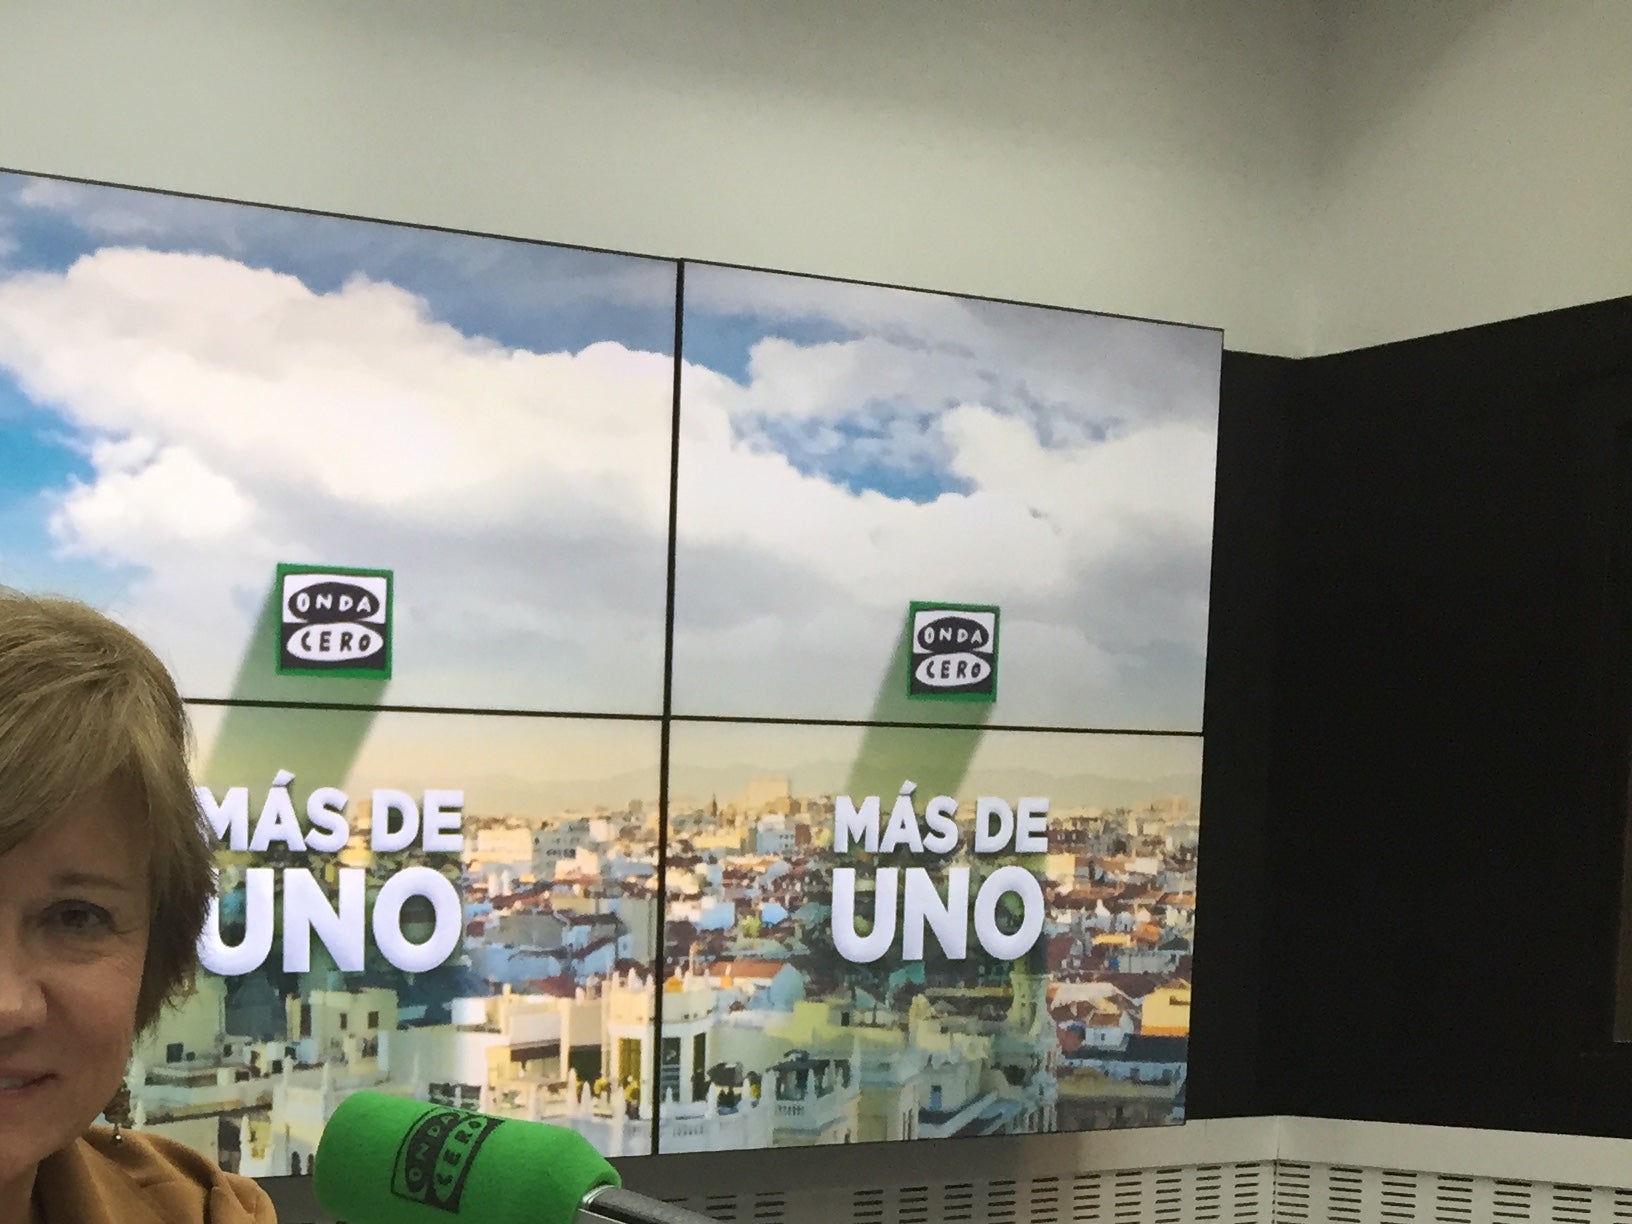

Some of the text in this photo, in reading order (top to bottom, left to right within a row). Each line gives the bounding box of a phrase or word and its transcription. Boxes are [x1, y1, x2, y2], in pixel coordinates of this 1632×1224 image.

[295, 592, 372, 614] ONDA
[923, 625, 984, 645] ONDA
[300, 630, 372, 653] CERO
[925, 659, 982, 679] CERO
[196, 769, 465, 852] MÁS DE
[833, 779, 1050, 854] MÁS DE
[196, 866, 463, 976] UNO
[831, 865, 1046, 963] UNO
[408, 1115, 454, 1182] ONDA
[436, 1120, 483, 1186] CERO
